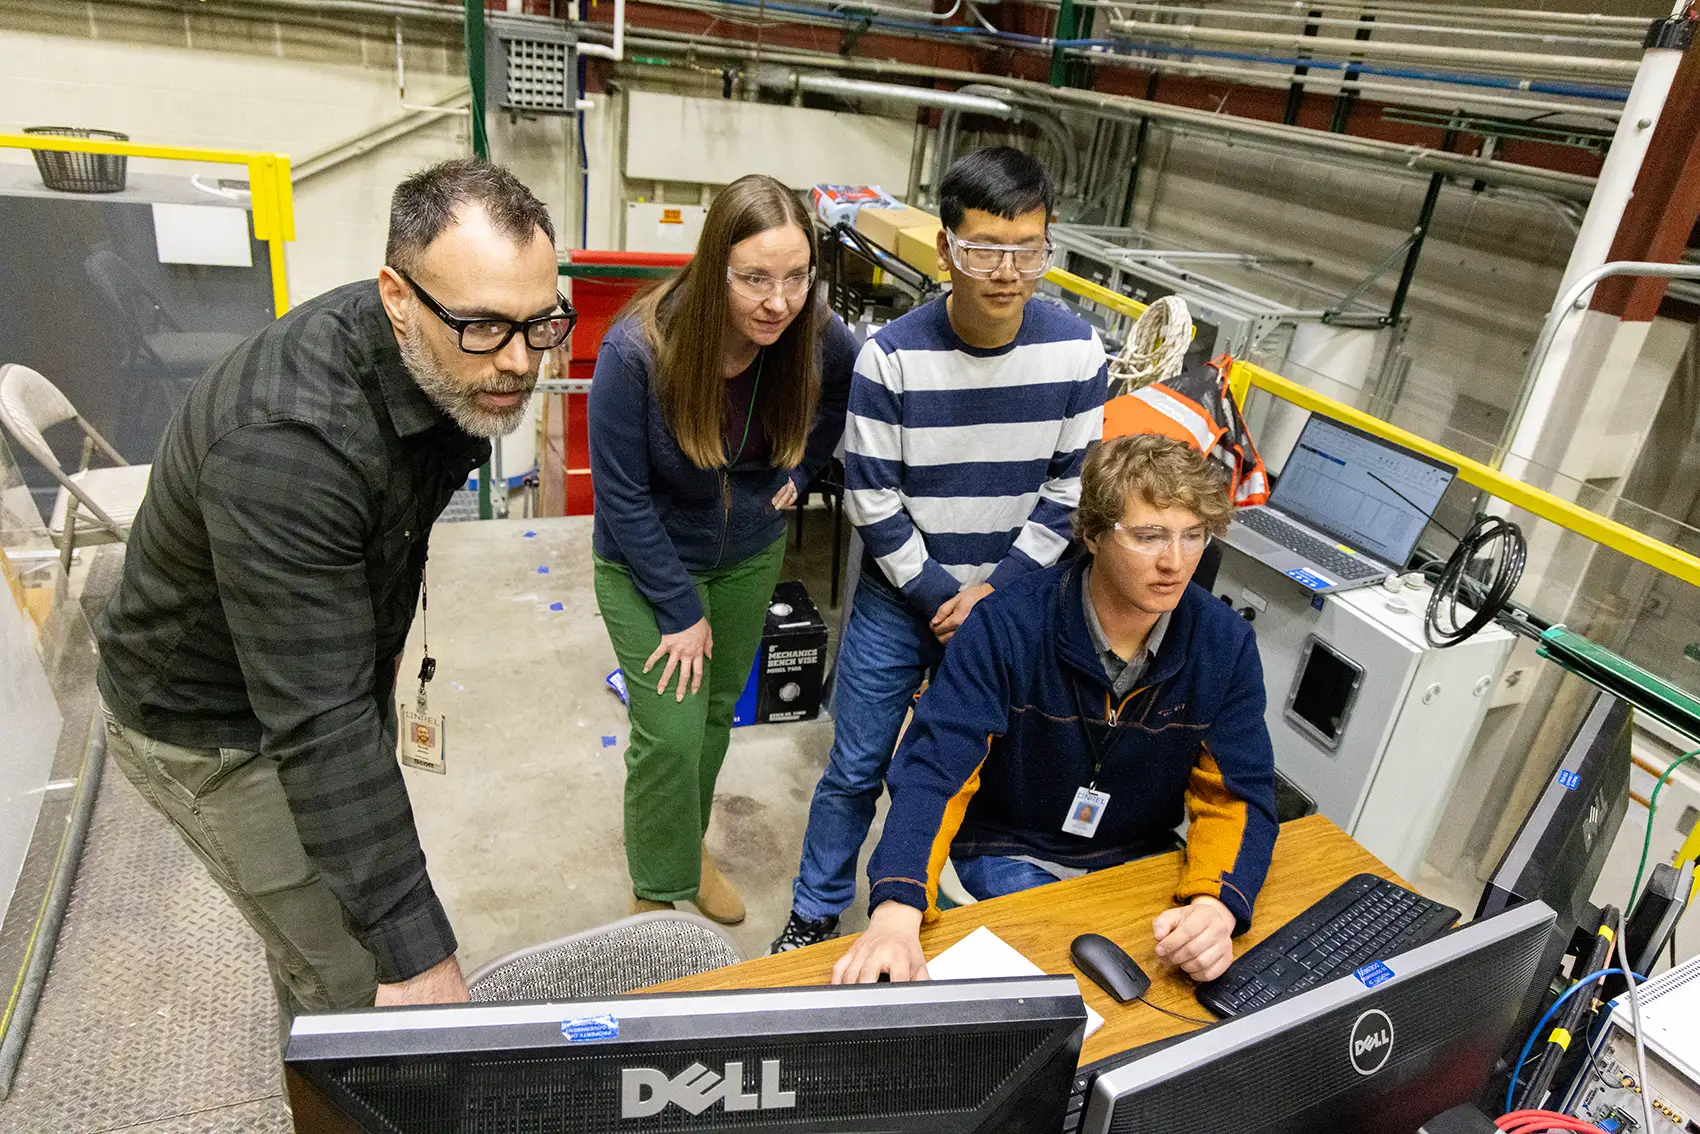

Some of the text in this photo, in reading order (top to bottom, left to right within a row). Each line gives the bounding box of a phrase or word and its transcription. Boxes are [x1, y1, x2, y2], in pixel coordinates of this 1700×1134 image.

[768, 649, 818, 660] MECHANICS
[767, 656, 818, 667] BENCH VISE
[413, 759, 435, 768] Scott
[1355, 1029, 1389, 1057] DELL
[622, 1060, 796, 1119] DELL
